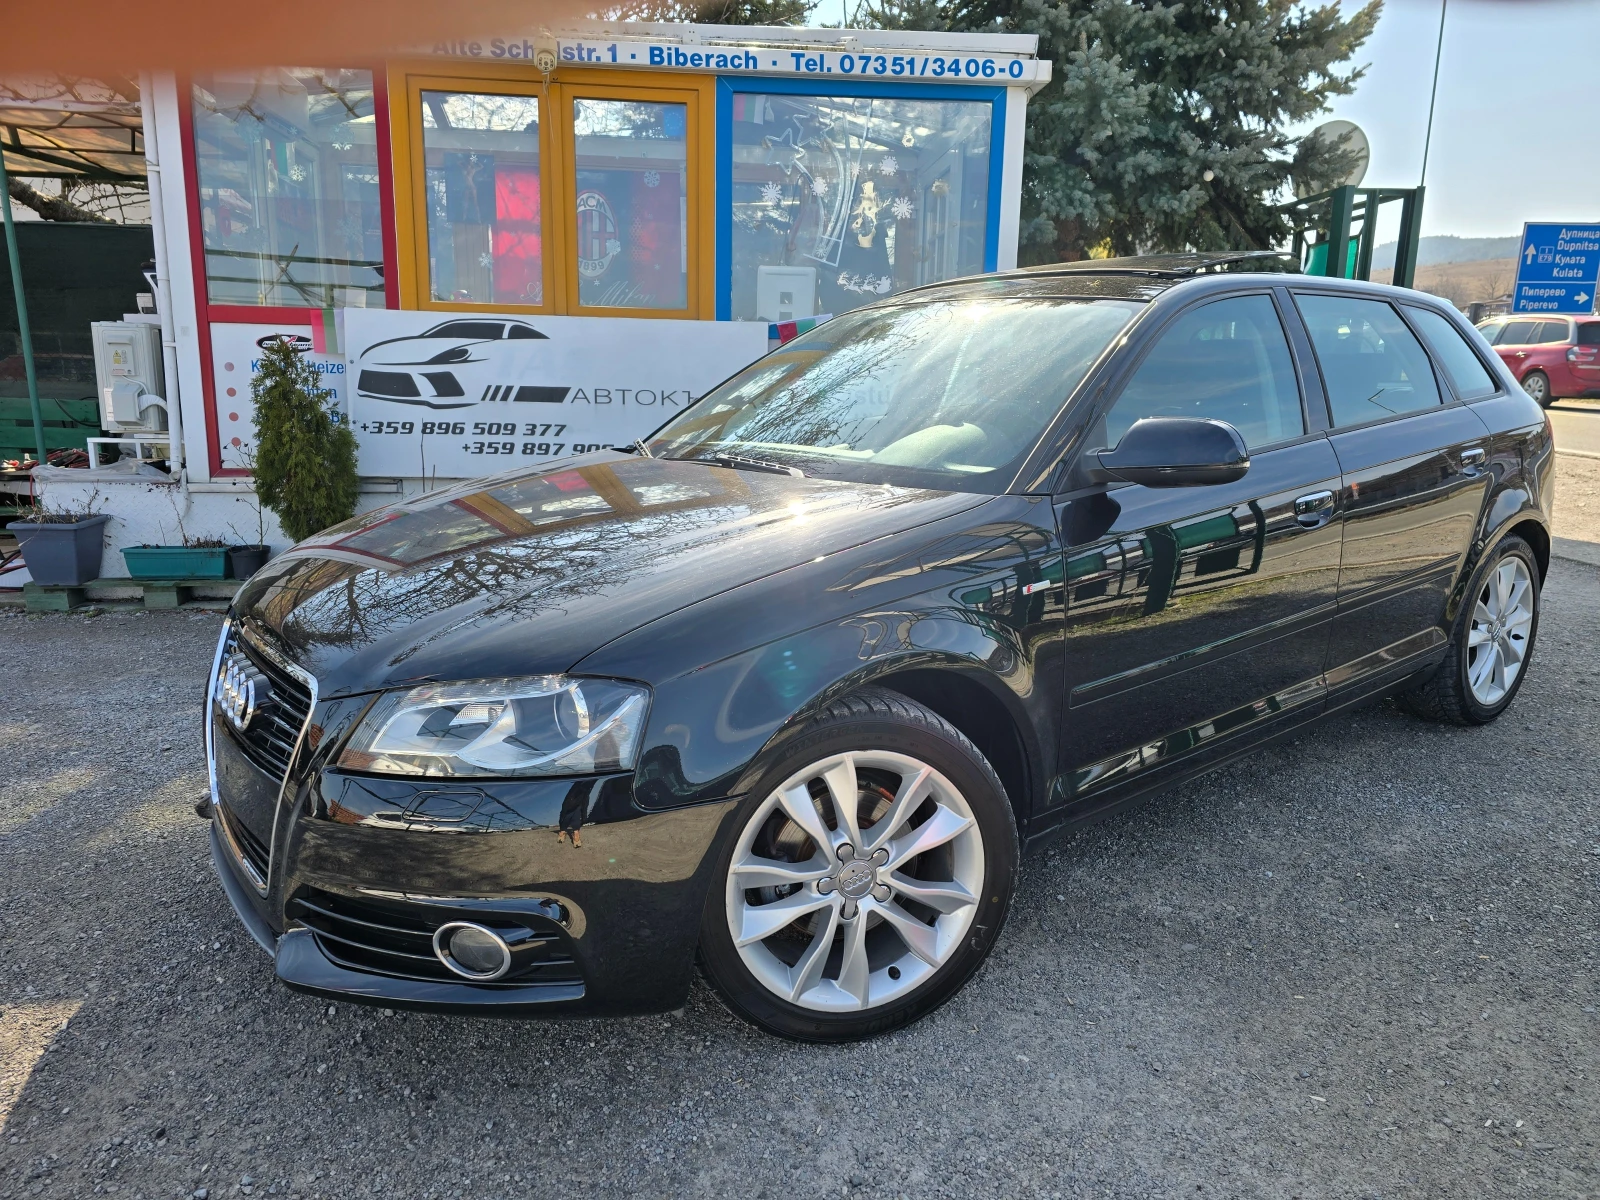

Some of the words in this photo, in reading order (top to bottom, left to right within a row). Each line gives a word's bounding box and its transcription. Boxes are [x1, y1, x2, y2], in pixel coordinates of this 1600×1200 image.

[432, 37, 483, 56] Alte
[490, 37, 602, 61] Schlstr.
[649, 46, 758, 70] Biberach
[791, 52, 832, 73] Tel.
[839, 54, 1024, 79] 07351/3406-0
[1559, 228, 1600, 240] Дупница
[1557, 240, 1599, 252] Dupnitsa
[1555, 254, 1586, 266] Кулата
[1552, 267, 1583, 278] Kulata
[1522, 286, 1566, 298] Пиперево
[1519, 299, 1559, 311] Piperevo
[360, 421, 415, 435] +359
[420, 421, 466, 435] 896
[472, 422, 517, 436] 509
[523, 423, 567, 437] 377
[462, 441, 516, 455] +359
[521, 442, 566, 456] 897
